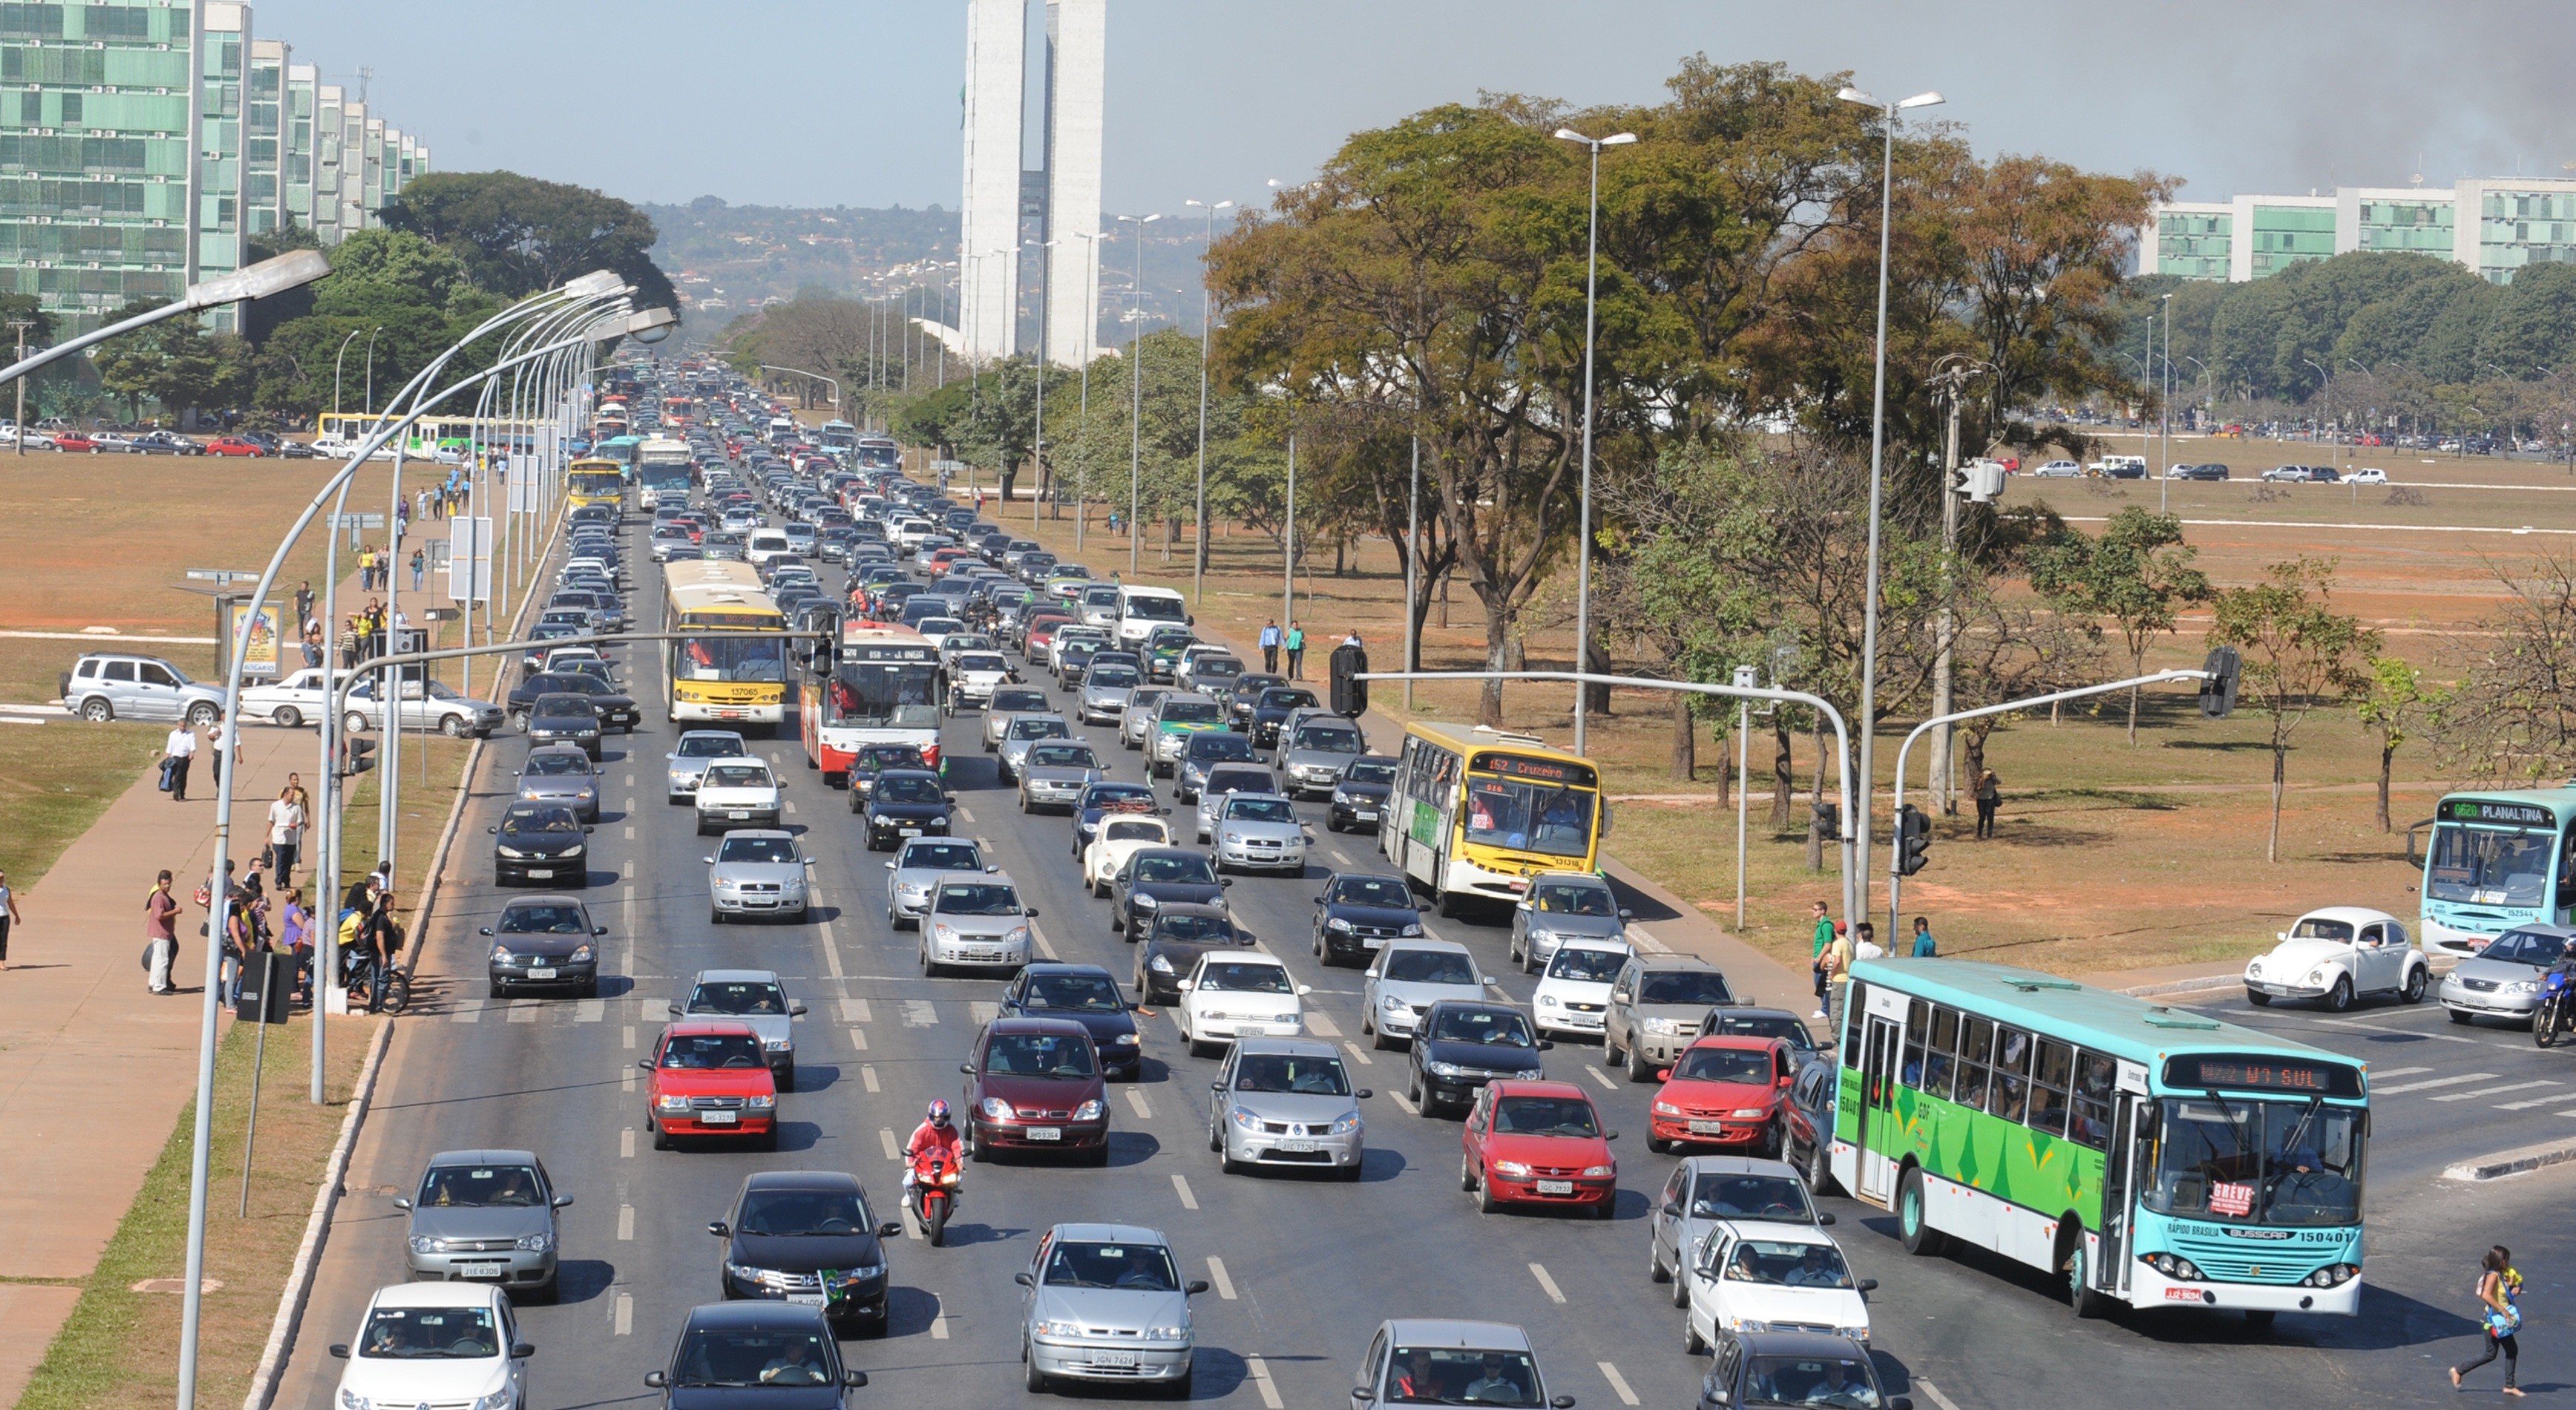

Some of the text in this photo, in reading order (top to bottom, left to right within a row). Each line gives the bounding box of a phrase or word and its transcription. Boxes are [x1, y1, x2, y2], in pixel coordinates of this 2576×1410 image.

[731, 688, 759, 696] 137065
[1488, 758, 1563, 778] 152 Cruzeiro
[2482, 805, 2544, 822] PLANALTINA
[1473, 818, 1486, 827] 200
[1555, 858, 1579, 867] 131318
[2280, 1068, 2316, 1088] SUL
[1918, 1102, 1929, 1121] GDF
[2213, 1182, 2253, 1202] GREVE
[2230, 1228, 2288, 1239] BUSSCAR
[2300, 1231, 2351, 1243] 150401
[1114, 1357, 1133, 1365] 7626
